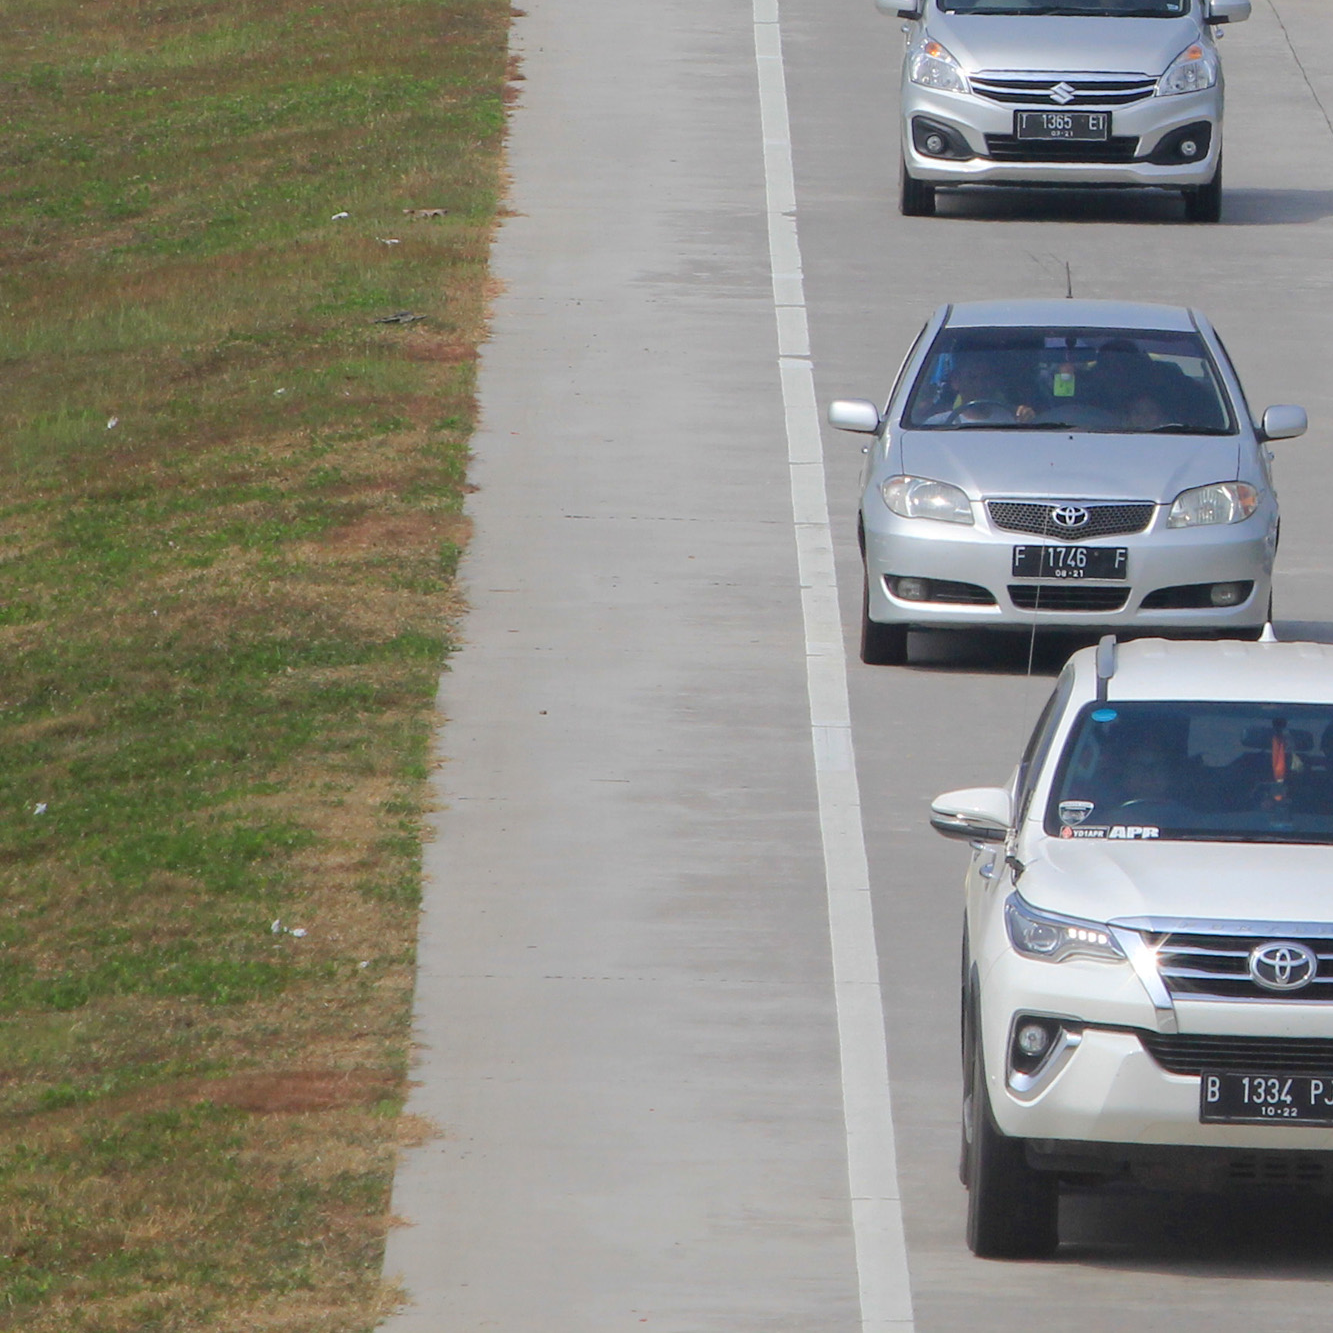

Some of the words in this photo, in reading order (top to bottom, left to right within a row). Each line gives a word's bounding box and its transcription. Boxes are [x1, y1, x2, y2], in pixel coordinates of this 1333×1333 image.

[1021, 114, 1028, 128] T
[1042, 114, 1073, 129] 1365
[1015, 546, 1026, 566] F
[1048, 547, 1087, 568] 1746
[1114, 549, 1126, 568] F
[1108, 826, 1160, 839] APR
[1206, 1076, 1221, 1102] B
[1241, 1077, 1293, 1104] 1334
